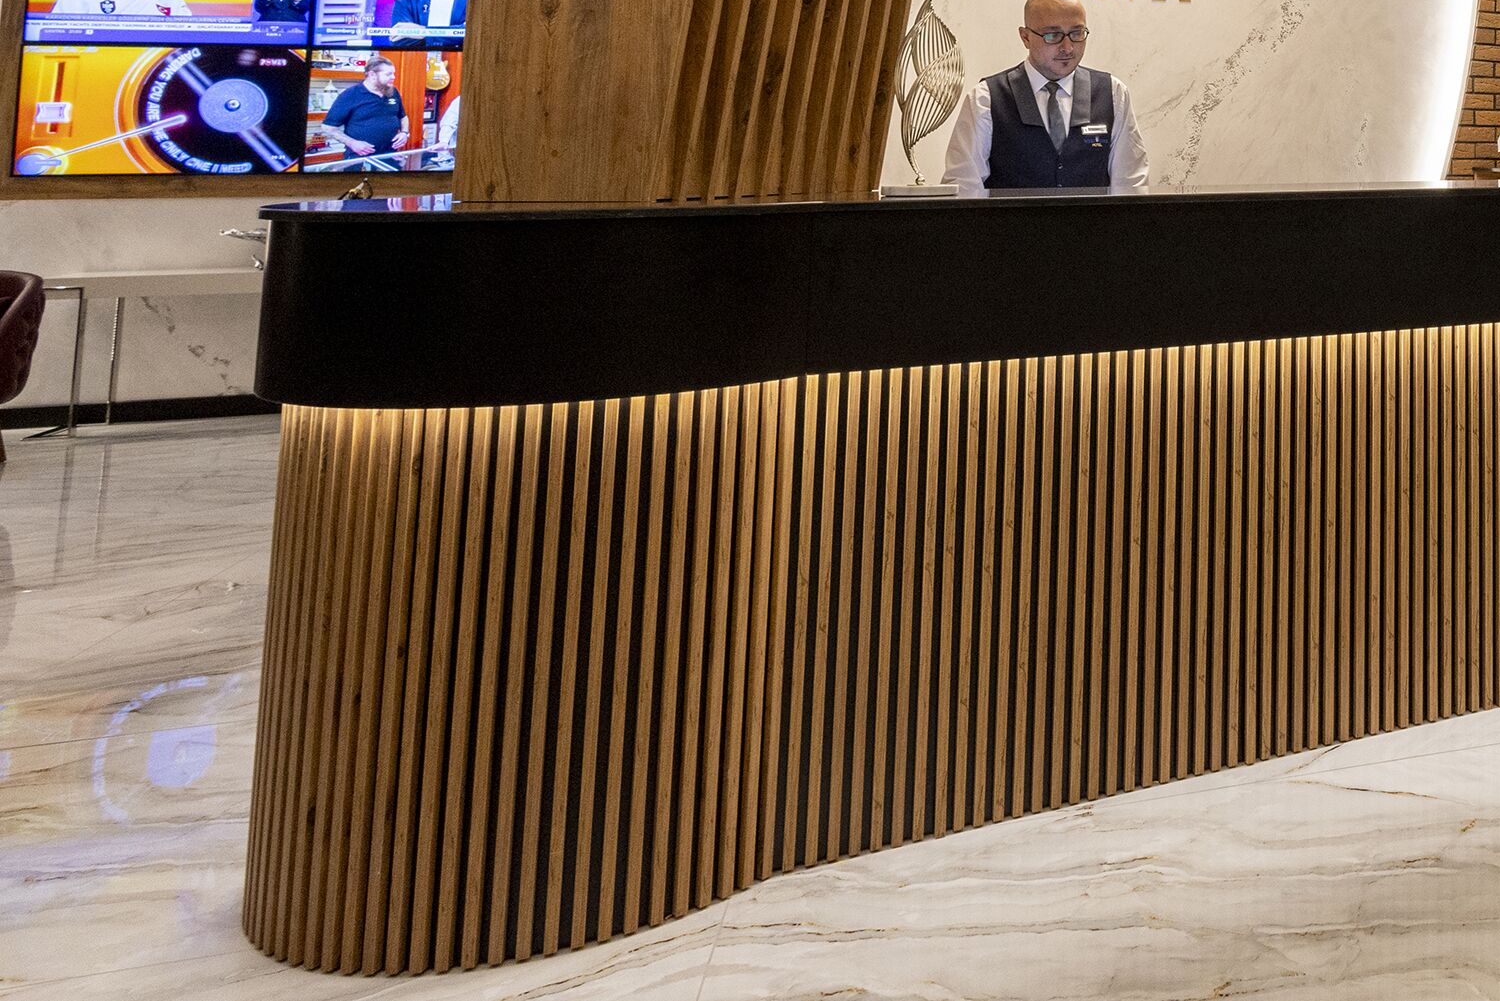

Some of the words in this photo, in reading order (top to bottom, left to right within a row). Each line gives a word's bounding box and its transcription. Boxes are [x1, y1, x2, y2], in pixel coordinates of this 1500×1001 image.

[148, 80, 167, 102] YOU
[146, 101, 160, 123] ARE
[160, 140, 190, 162] ONLY
[184, 157, 212, 172] ONE
[218, 162, 252, 173] NEED
